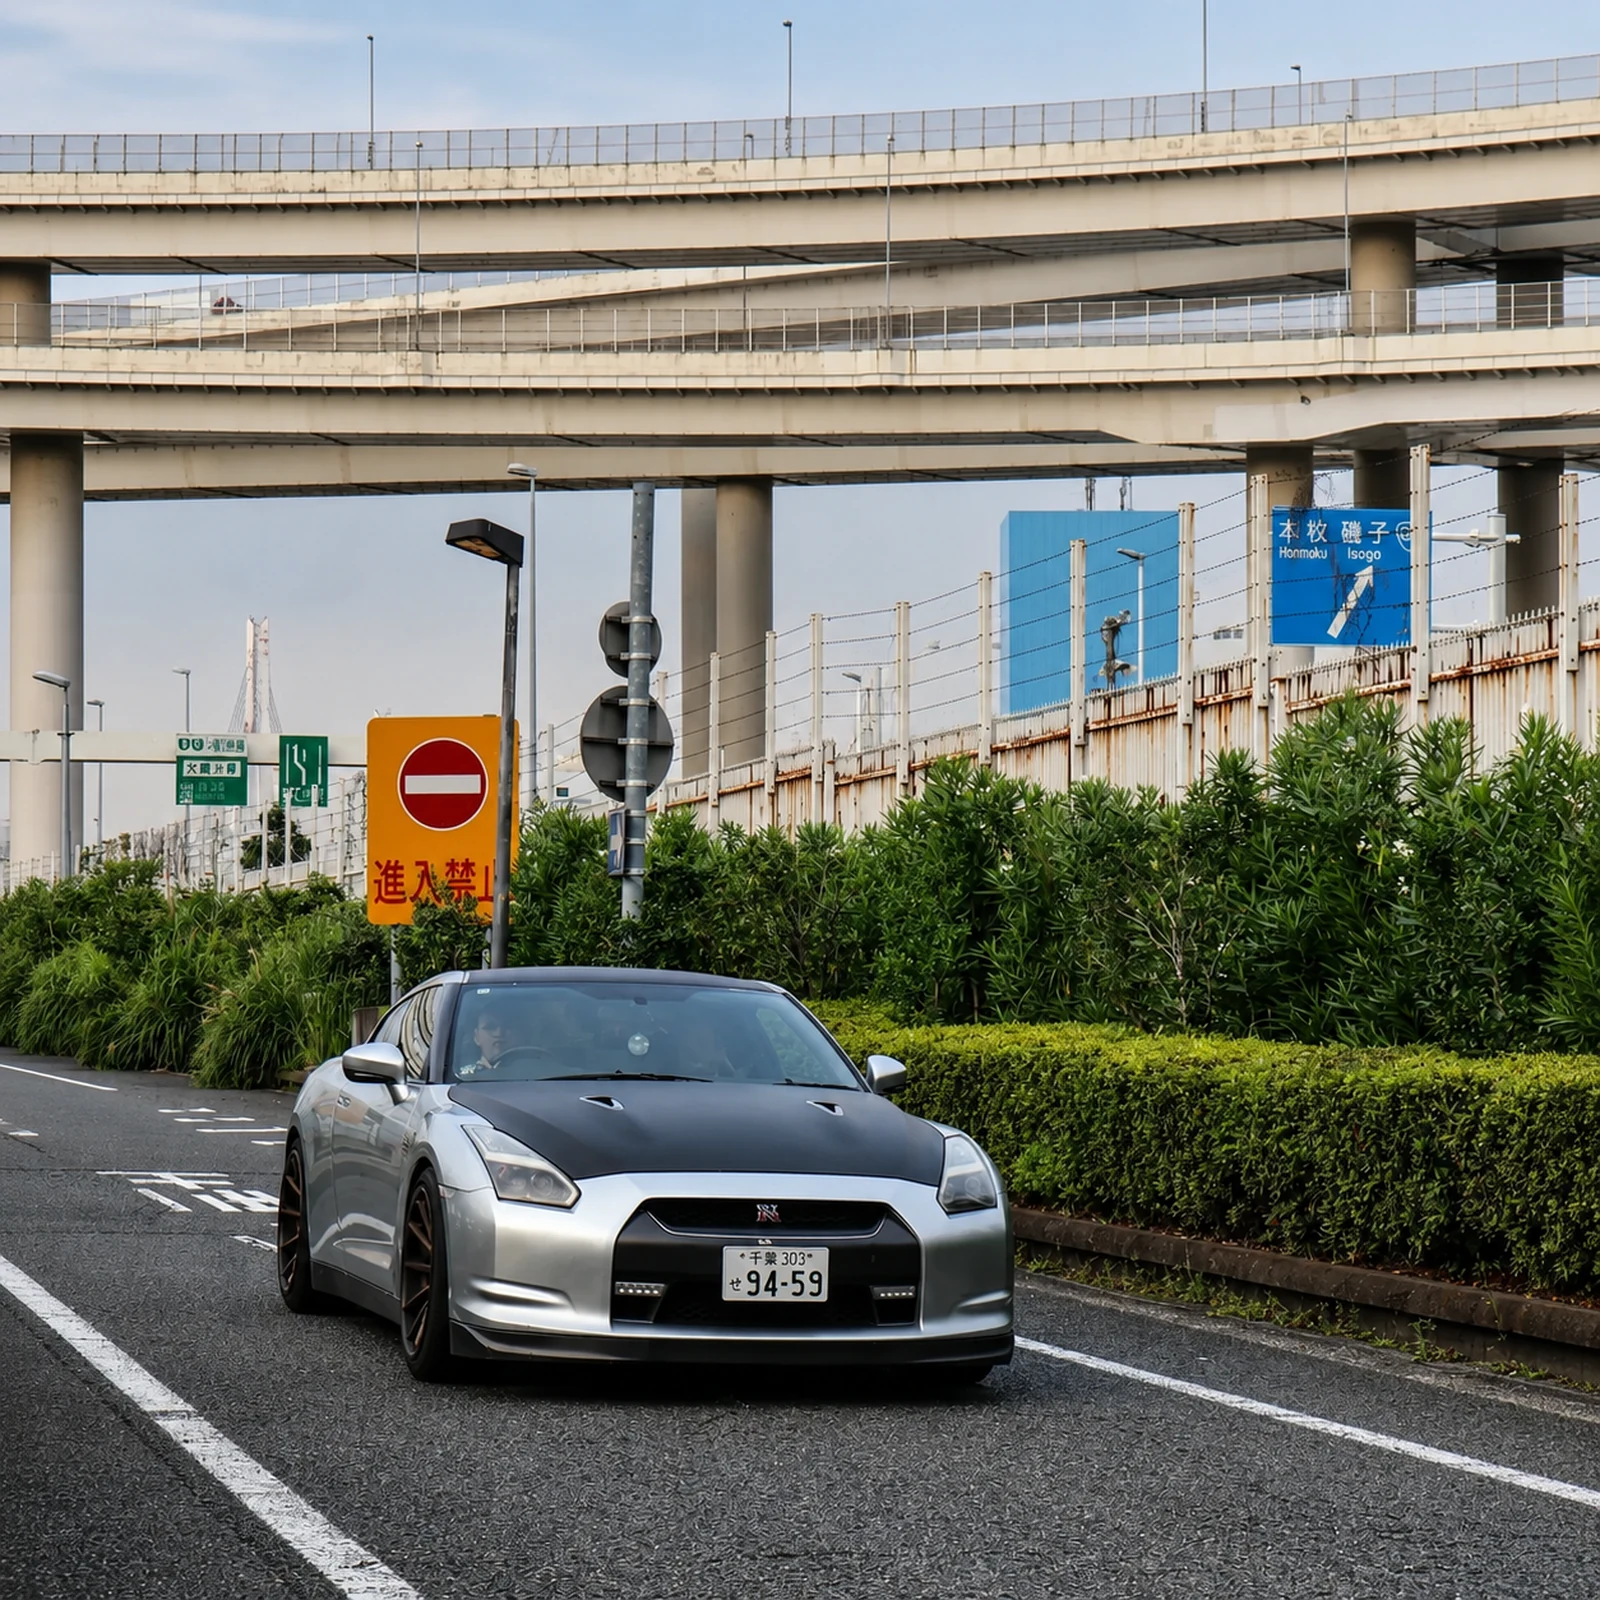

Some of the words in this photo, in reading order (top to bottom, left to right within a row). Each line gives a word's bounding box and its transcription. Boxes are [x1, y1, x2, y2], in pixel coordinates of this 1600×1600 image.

[1280, 546, 1328, 559] Honmoku
[1347, 547, 1381, 563] Isogo
[781, 1252, 806, 1266] 303
[729, 1277, 742, 1291] せ
[746, 1270, 823, 1297] 94-59
